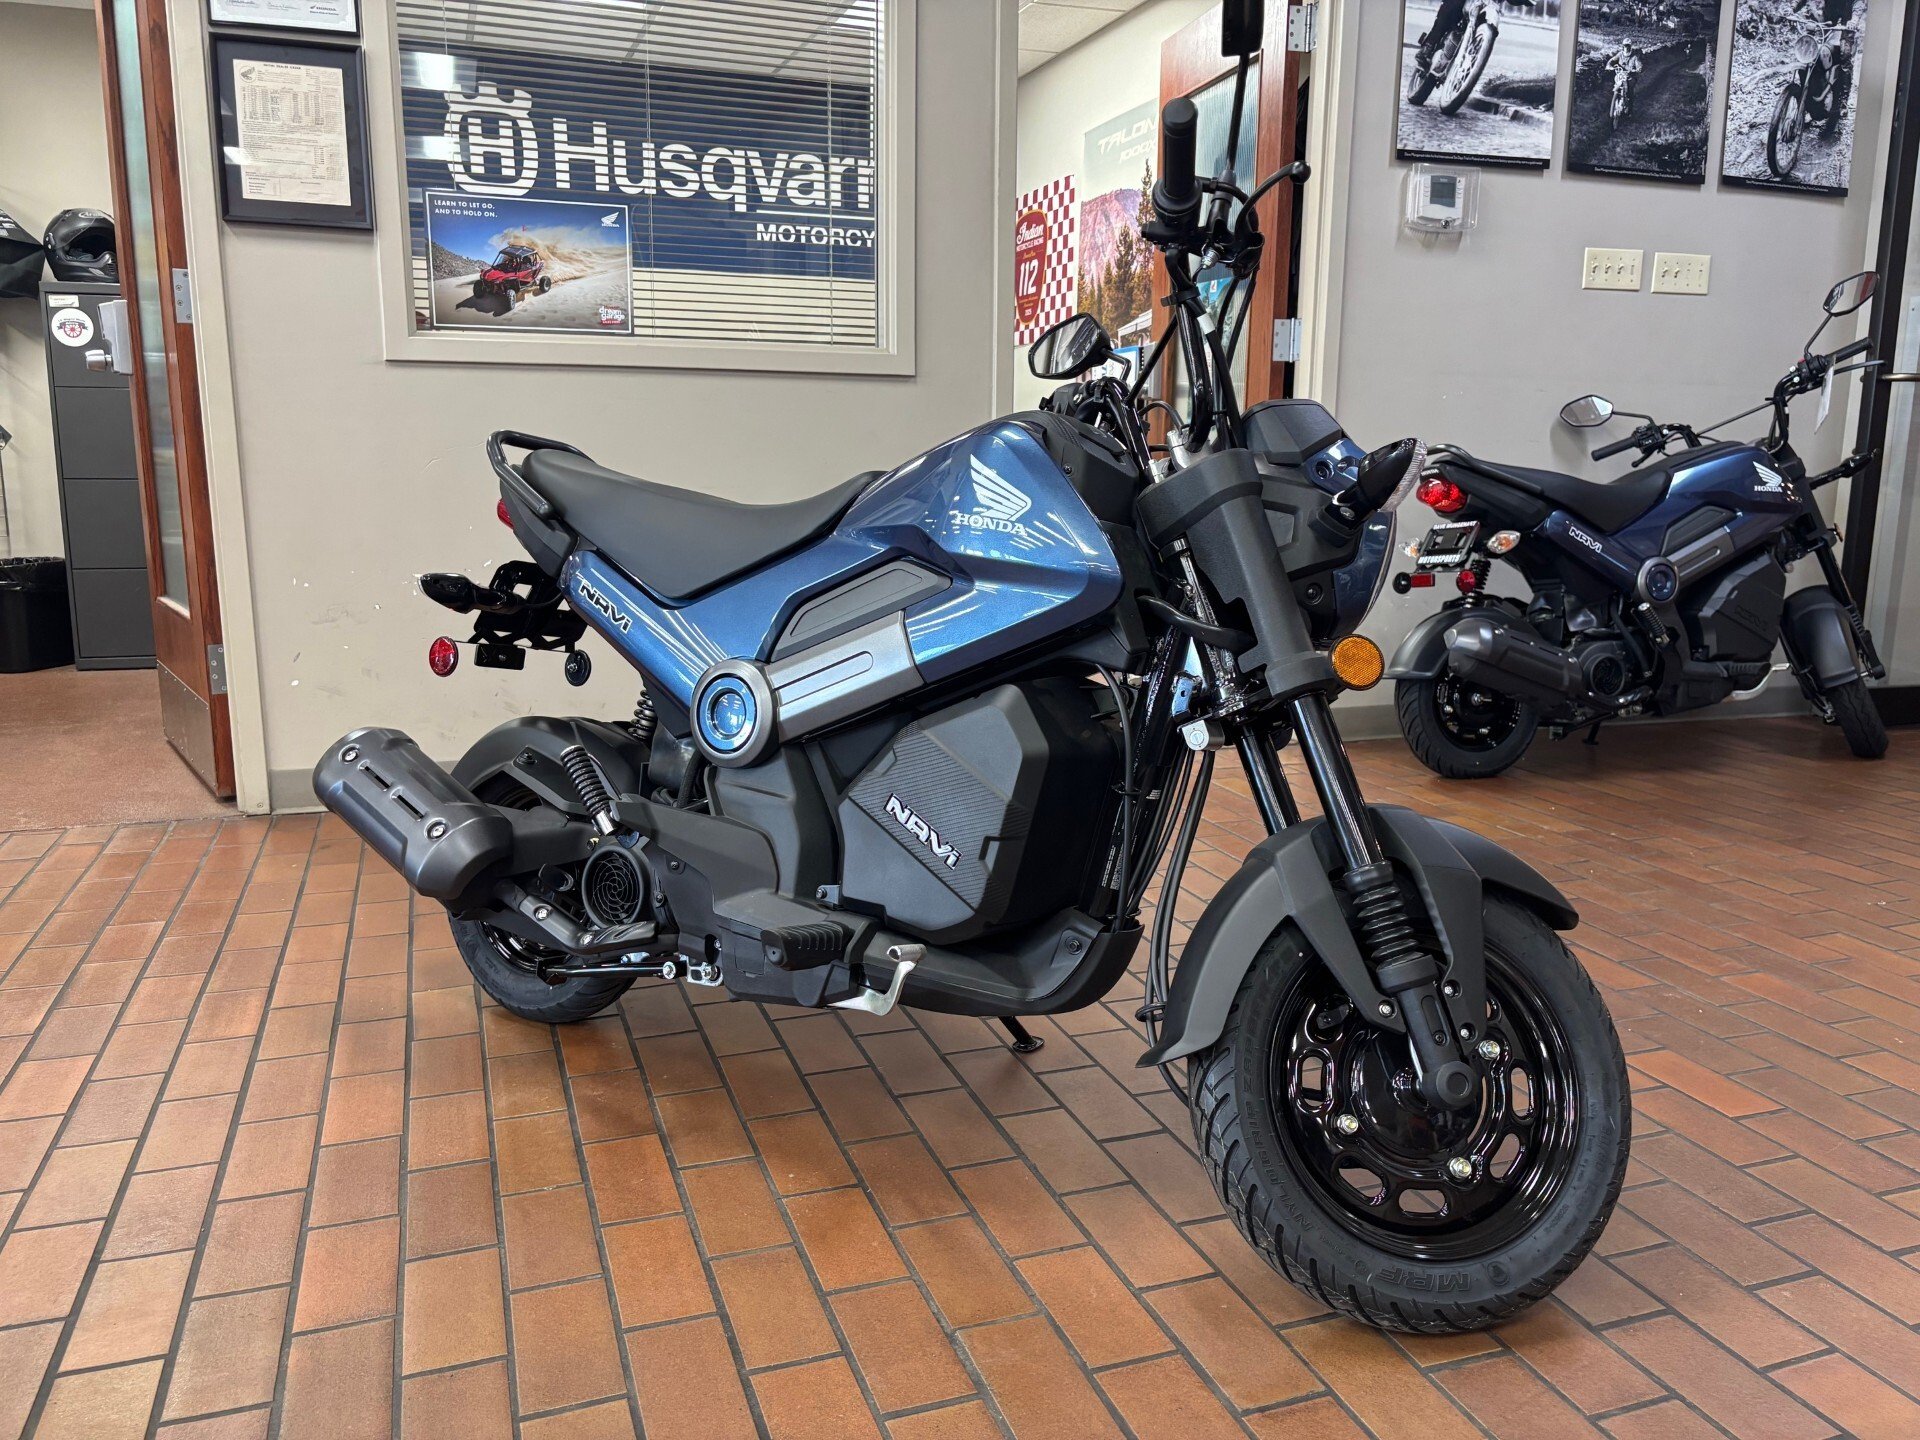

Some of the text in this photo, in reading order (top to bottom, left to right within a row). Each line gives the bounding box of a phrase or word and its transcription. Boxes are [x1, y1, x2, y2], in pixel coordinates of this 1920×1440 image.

[434, 199, 456, 207] LEARN
[1016, 222, 1044, 245] Indian
[1019, 258, 1039, 297] 112
[1753, 485, 1783, 493] HONDA
[955, 512, 1028, 537] HONDA
[1418, 554, 1461, 564] MOTORSPORTS
[1375, 1267, 1471, 1292] MRF
